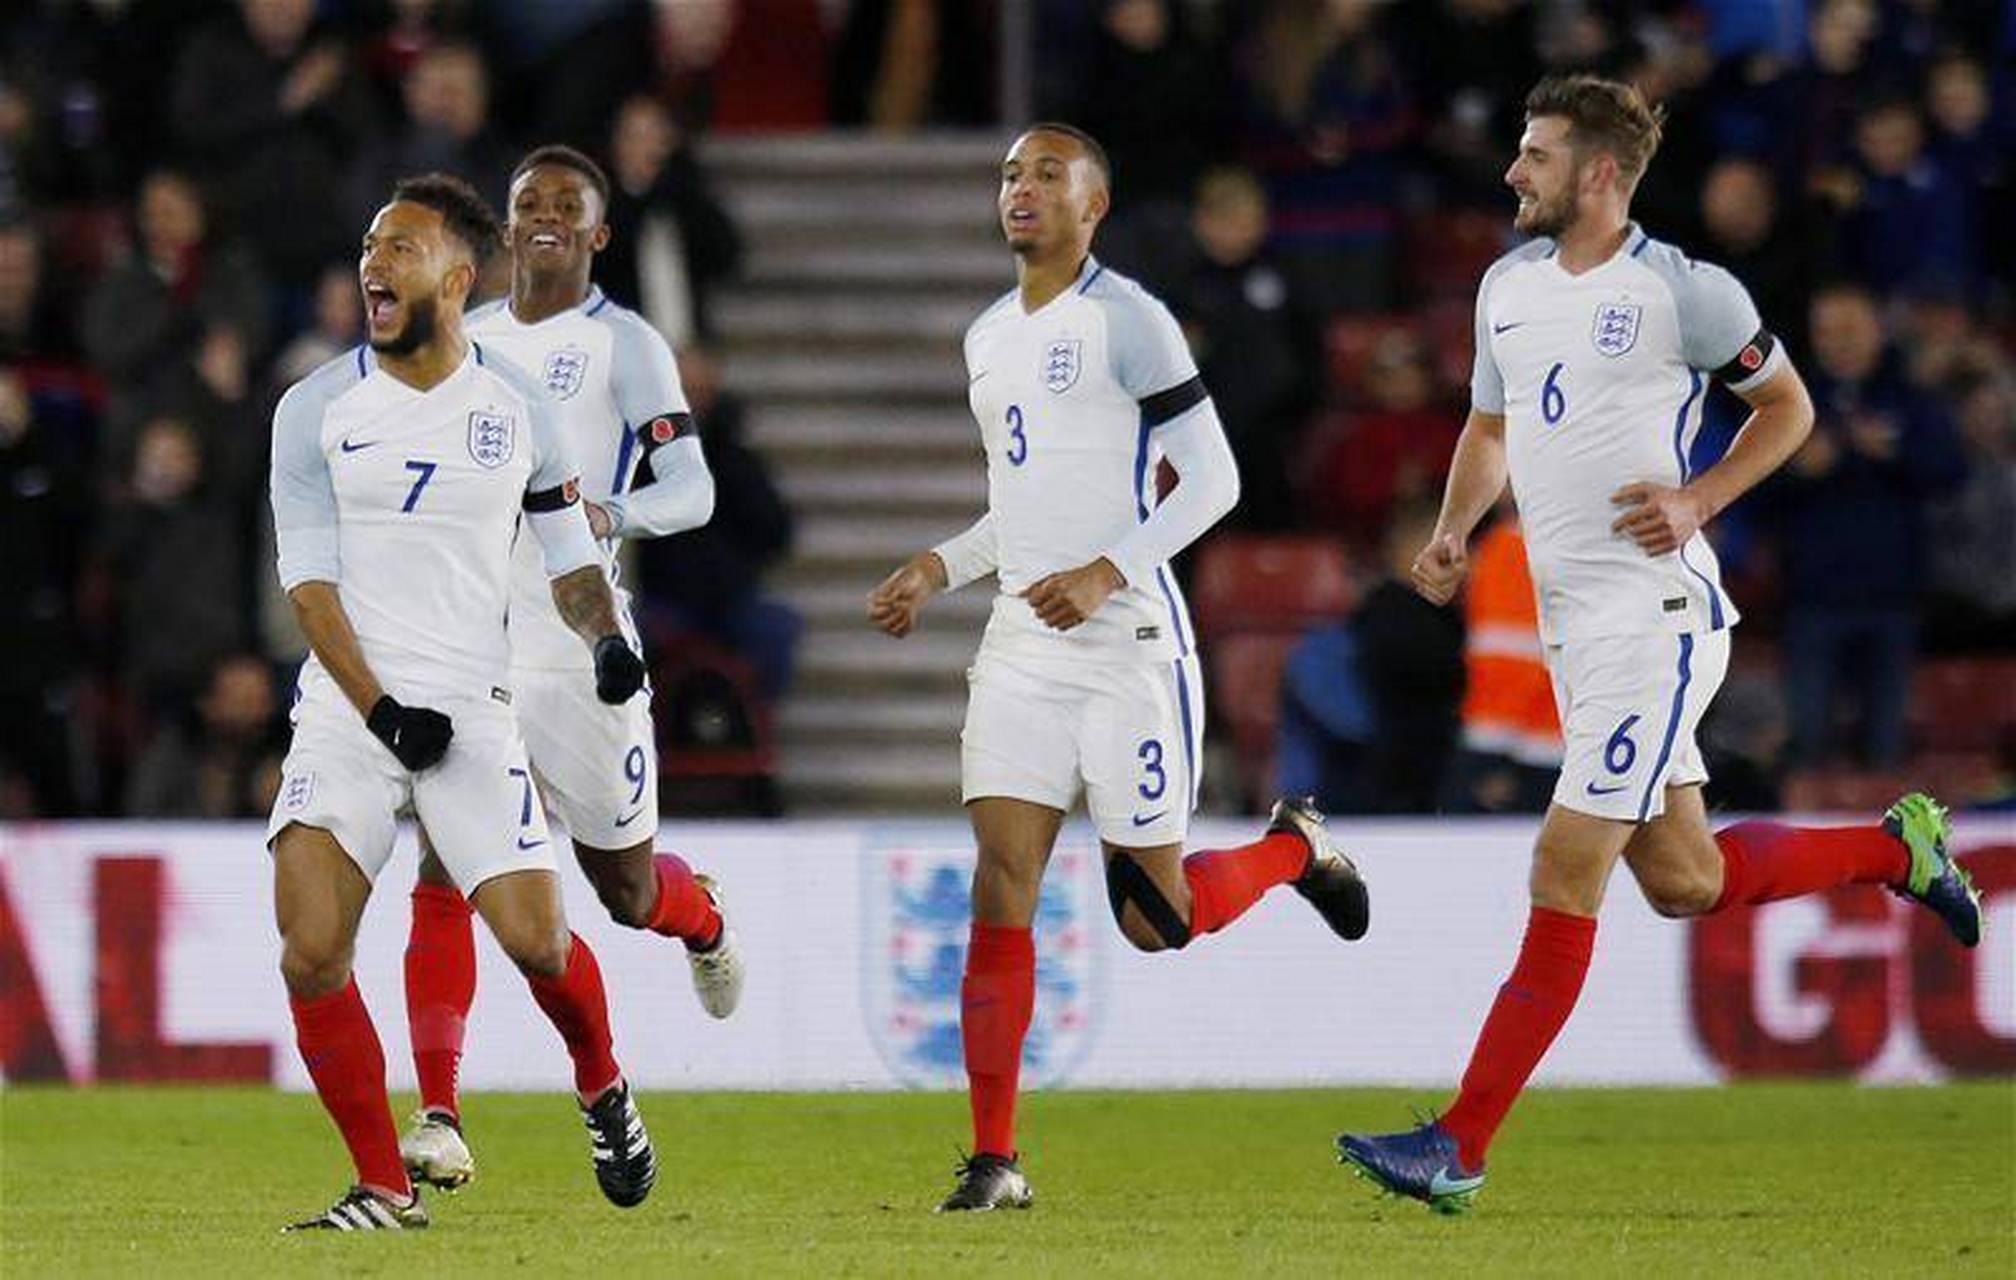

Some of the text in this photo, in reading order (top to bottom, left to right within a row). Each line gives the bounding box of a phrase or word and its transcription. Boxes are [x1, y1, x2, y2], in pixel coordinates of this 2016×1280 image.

[1542, 362, 1565, 423] 6
[1006, 404, 1027, 467] 3
[402, 460, 437, 513] 7
[624, 745, 646, 805] 9
[1138, 739, 1166, 801] 3
[1604, 714, 1642, 775] 6
[509, 767, 532, 827] 7
